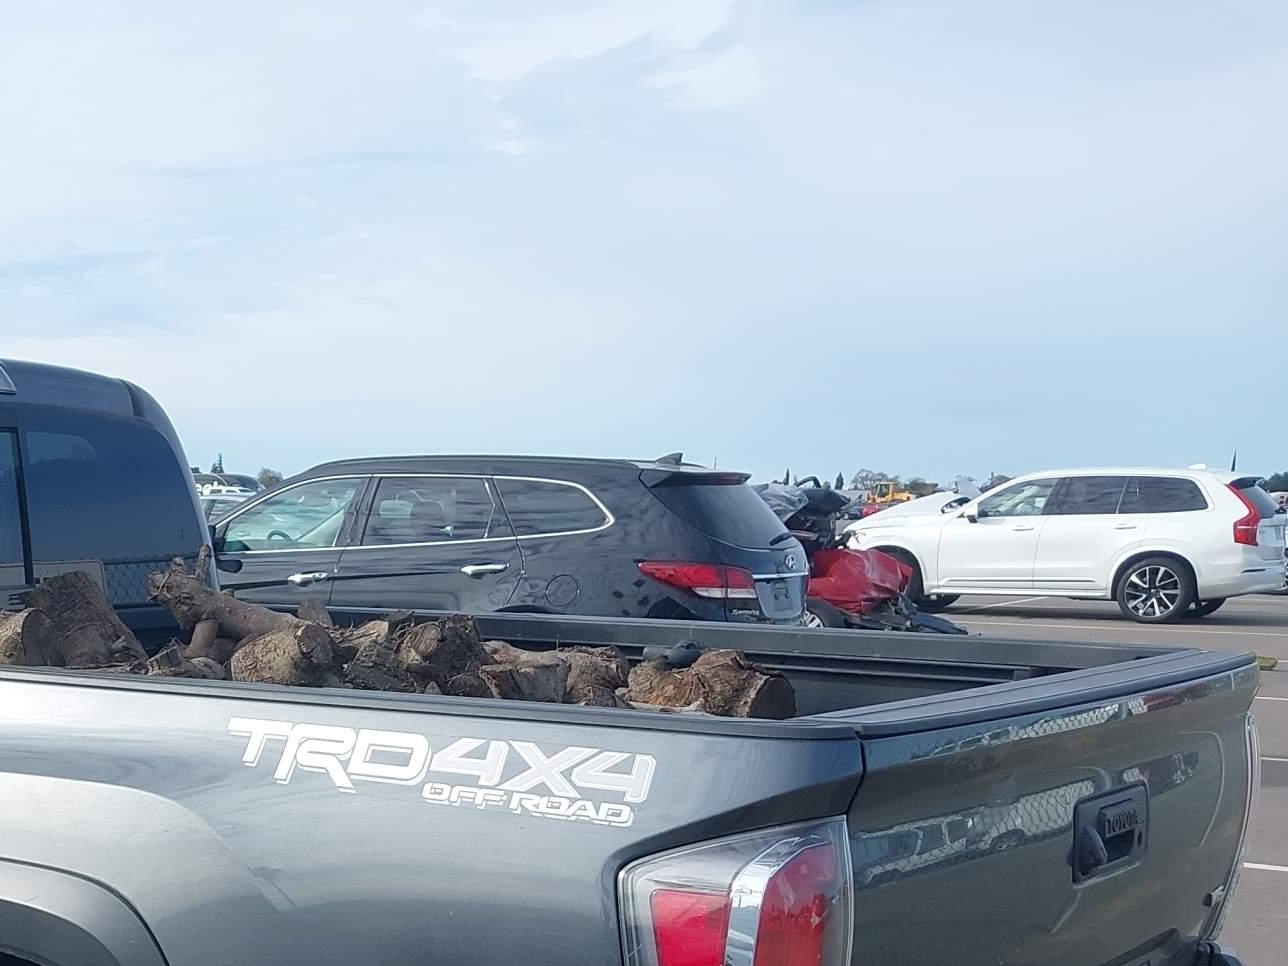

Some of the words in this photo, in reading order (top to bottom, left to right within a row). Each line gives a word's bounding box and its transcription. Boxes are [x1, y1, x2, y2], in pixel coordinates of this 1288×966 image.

[226, 716, 432, 794] TRD
[427, 736, 658, 804] 4X4
[421, 781, 507, 809] OFF
[508, 790, 634, 827] ROAD
